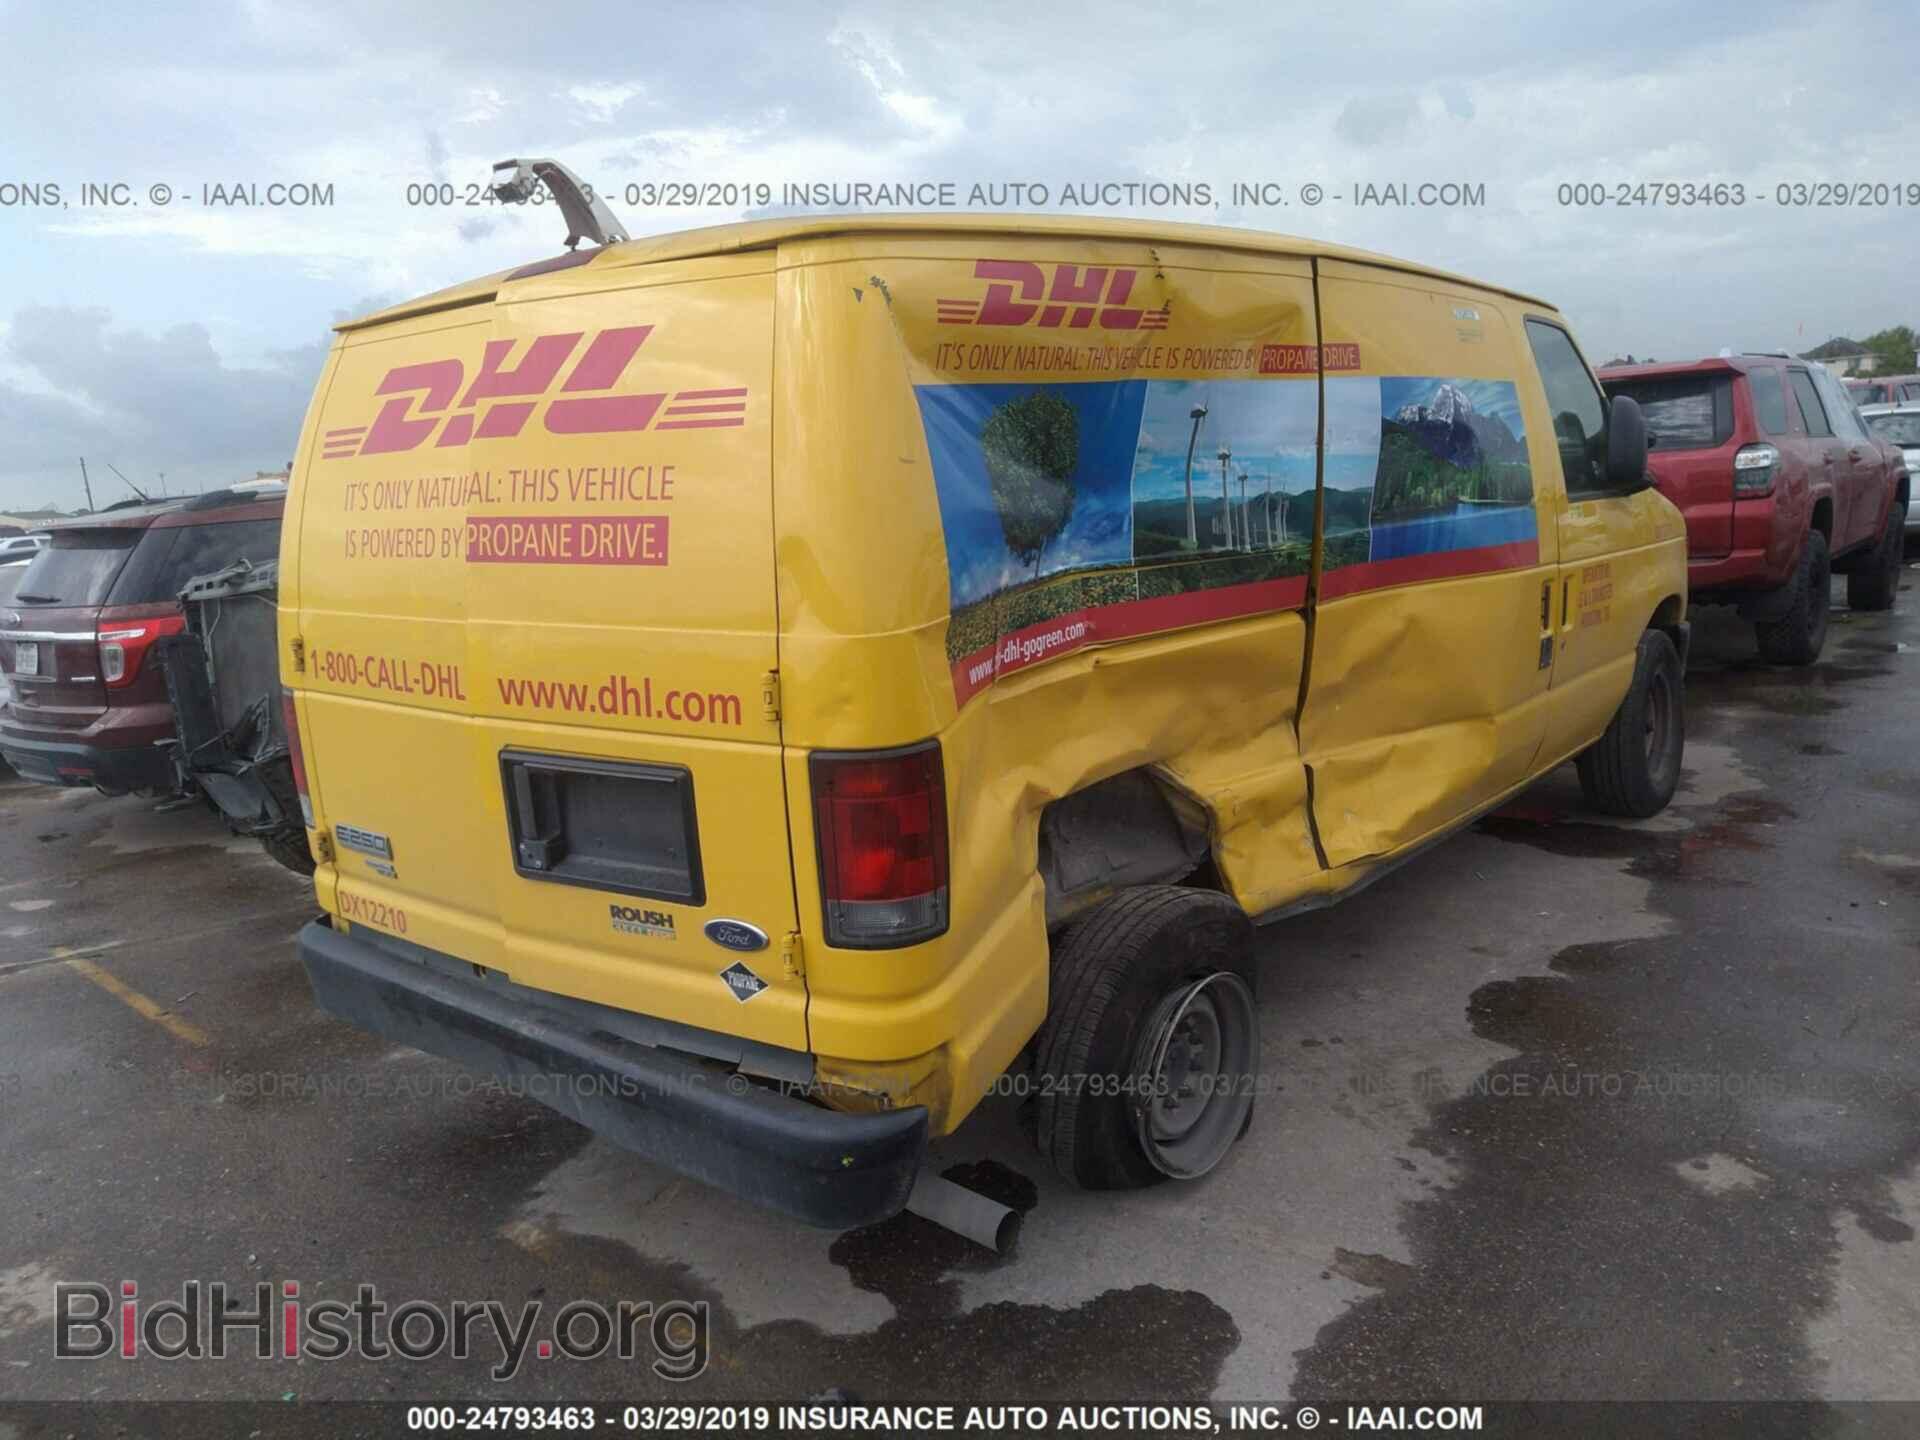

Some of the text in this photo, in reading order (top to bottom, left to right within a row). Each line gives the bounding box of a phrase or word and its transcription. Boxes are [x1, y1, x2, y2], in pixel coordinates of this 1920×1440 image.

[973, 257, 1146, 330] DHL
[935, 342, 965, 371] IT'S
[967, 343, 1011, 371] ONLY
[1165, 346, 1180, 370] IS
[1182, 347, 1242, 370] POWERED
[1260, 349, 1318, 371] PROPANE
[357, 324, 668, 456] DHL
[343, 481, 370, 513] IT'S
[371, 478, 413, 511] ONLY
[508, 469, 561, 503] THIS
[566, 465, 676, 502] VEHICLE
[343, 522, 665, 560] IS POWERED BY PROPANE DRIVE.
[310, 648, 467, 701] 1-800-CALL-DHL
[496, 674, 743, 727] www.dhl.com
[338, 890, 408, 935] DX12210
[609, 904, 675, 930] ROUSH
